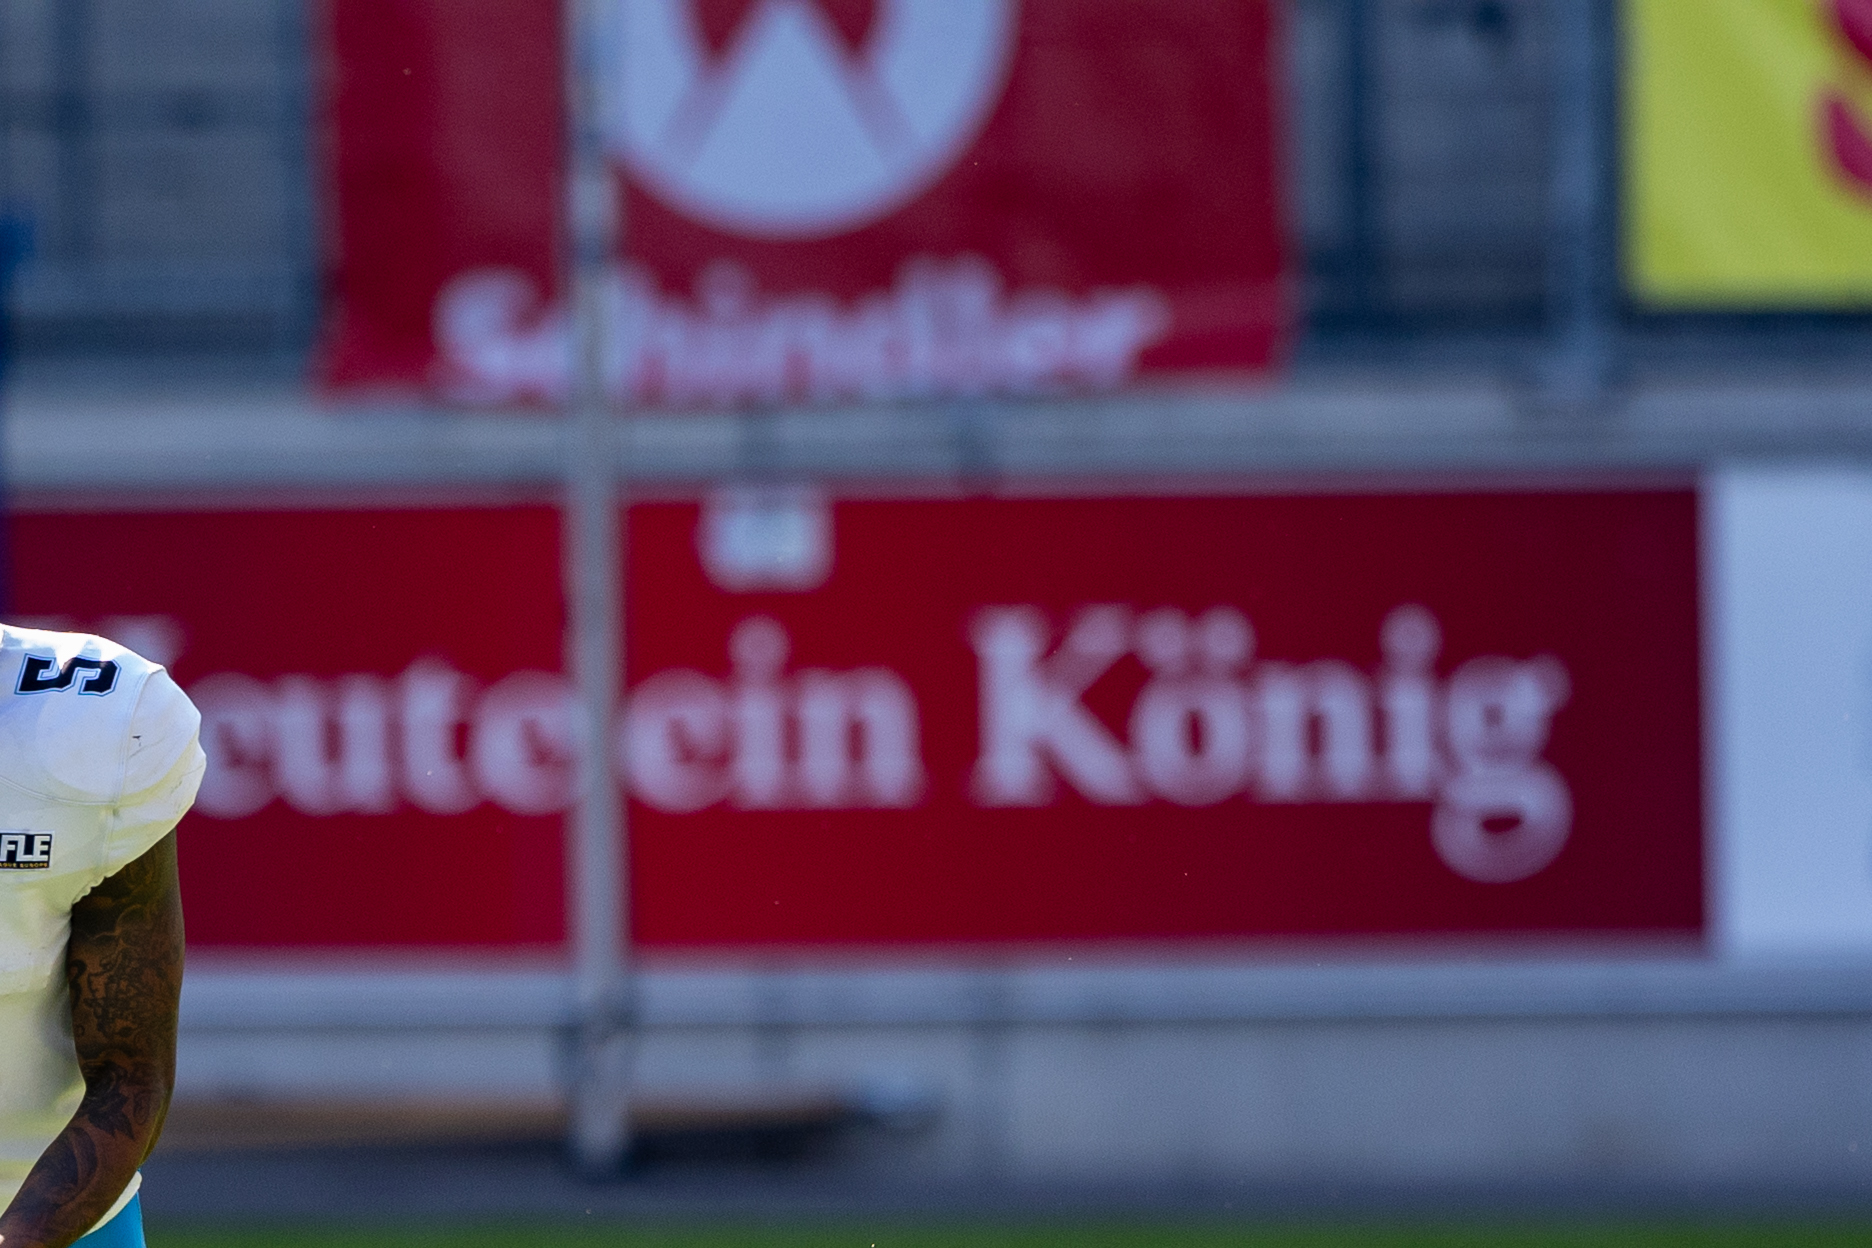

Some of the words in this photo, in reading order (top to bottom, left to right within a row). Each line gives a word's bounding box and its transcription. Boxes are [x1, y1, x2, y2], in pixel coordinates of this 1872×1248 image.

[14, 653, 122, 697] 5
[92, 614, 578, 815] eute
[622, 614, 924, 812] ein
[968, 604, 1574, 882] König
